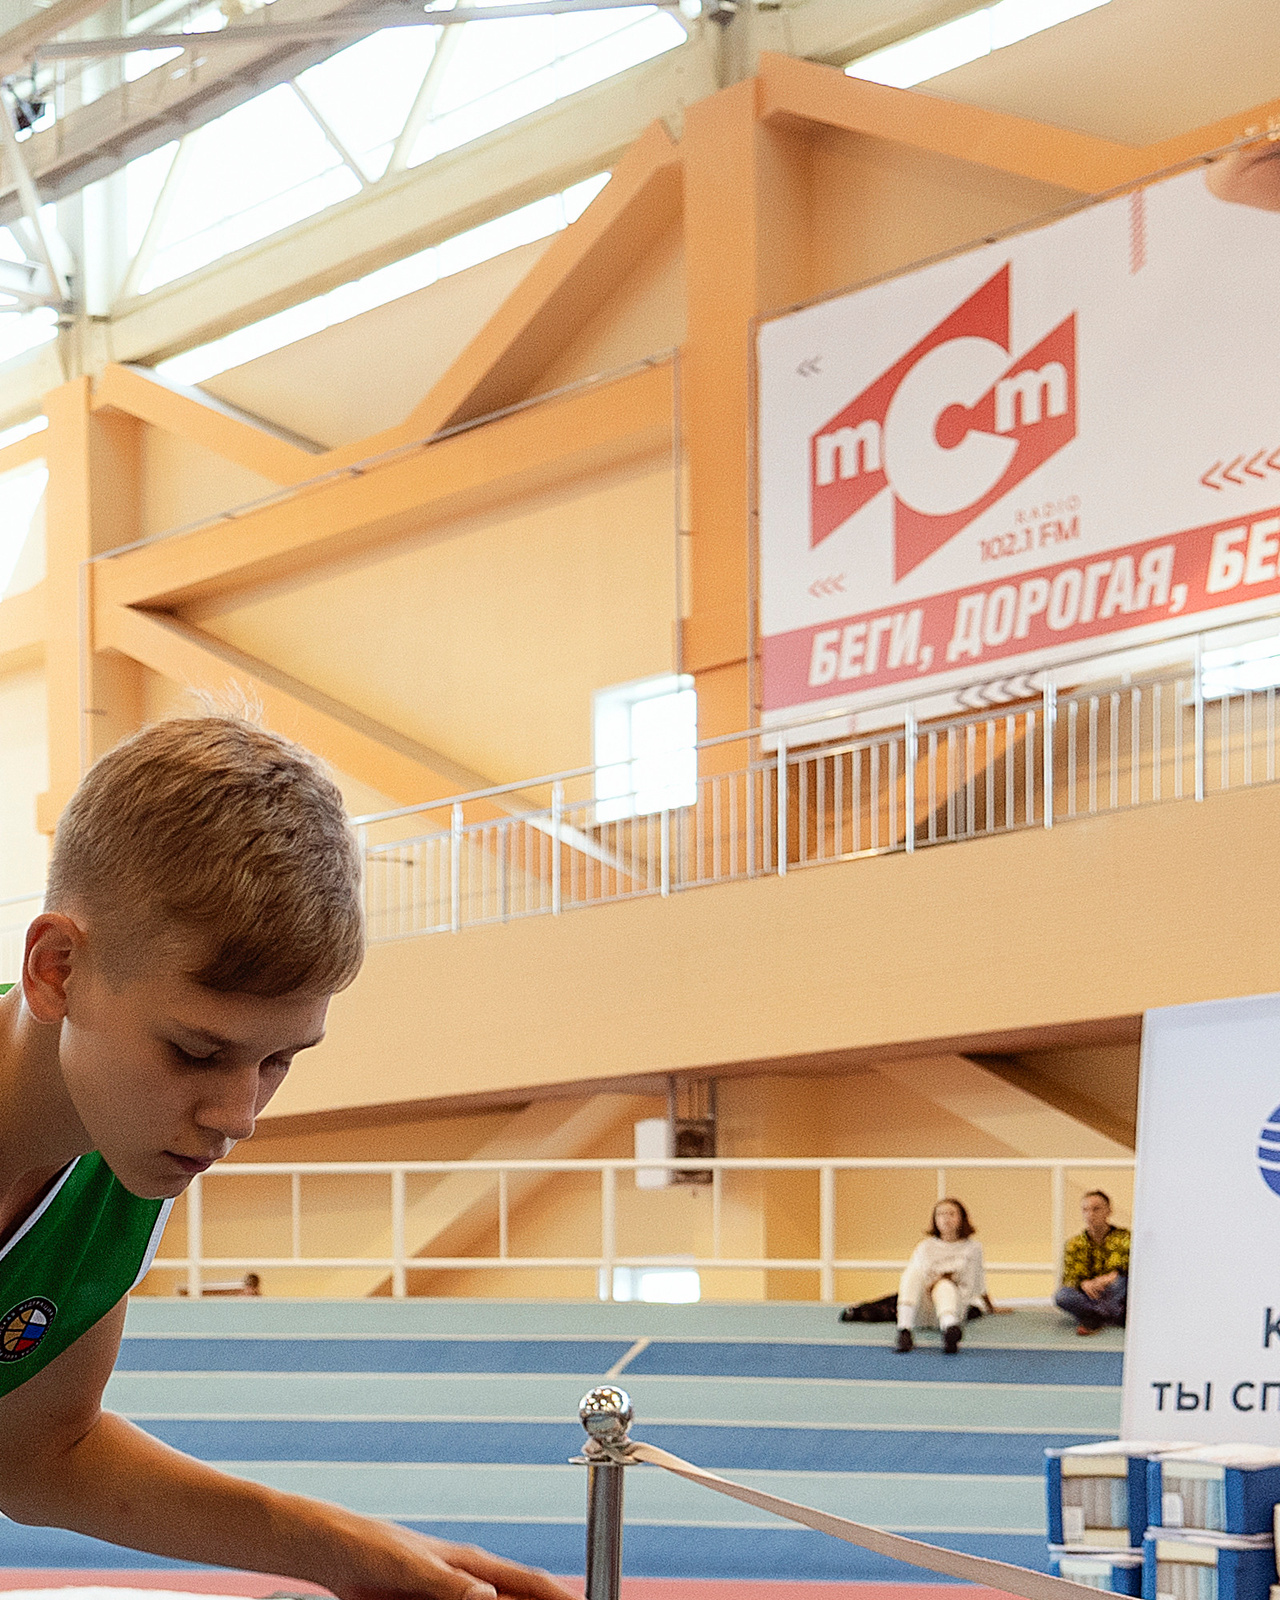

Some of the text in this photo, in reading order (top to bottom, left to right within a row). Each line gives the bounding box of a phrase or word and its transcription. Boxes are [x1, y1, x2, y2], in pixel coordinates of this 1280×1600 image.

[980, 514, 1081, 562] 102.1 FM
[808, 516, 1280, 687] БЕГИ, ДОРОГАЯ, БЕ
